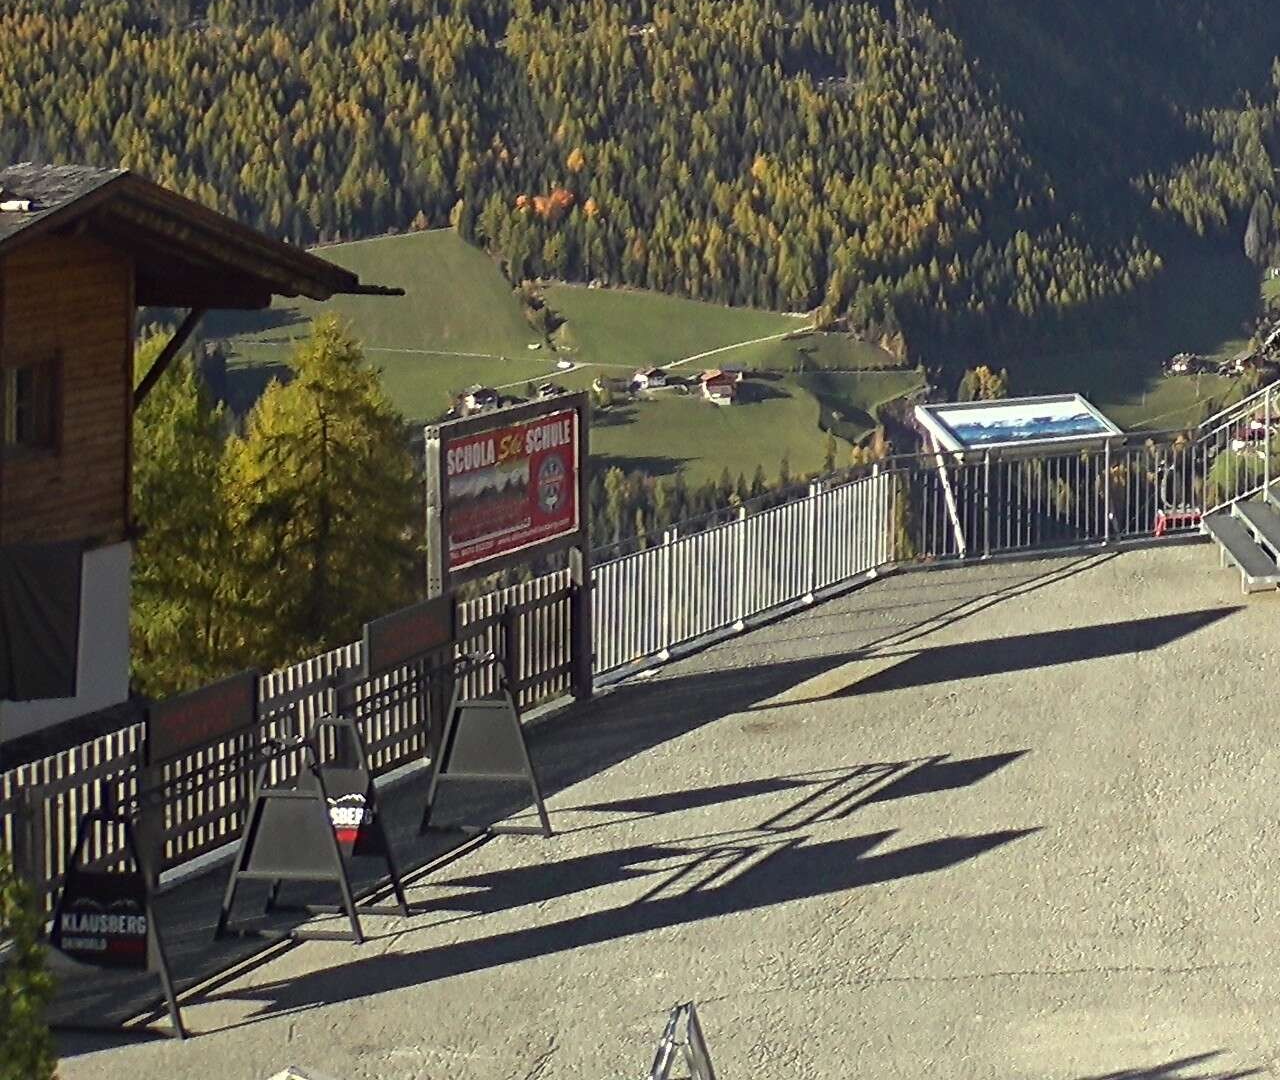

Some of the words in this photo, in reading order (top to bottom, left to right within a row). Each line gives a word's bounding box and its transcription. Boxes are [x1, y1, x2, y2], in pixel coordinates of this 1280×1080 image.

[447, 438, 496, 476] SCUOLA
[526, 419, 572, 454] SCHULE
[61, 913, 147, 935] KLAUSBERG
